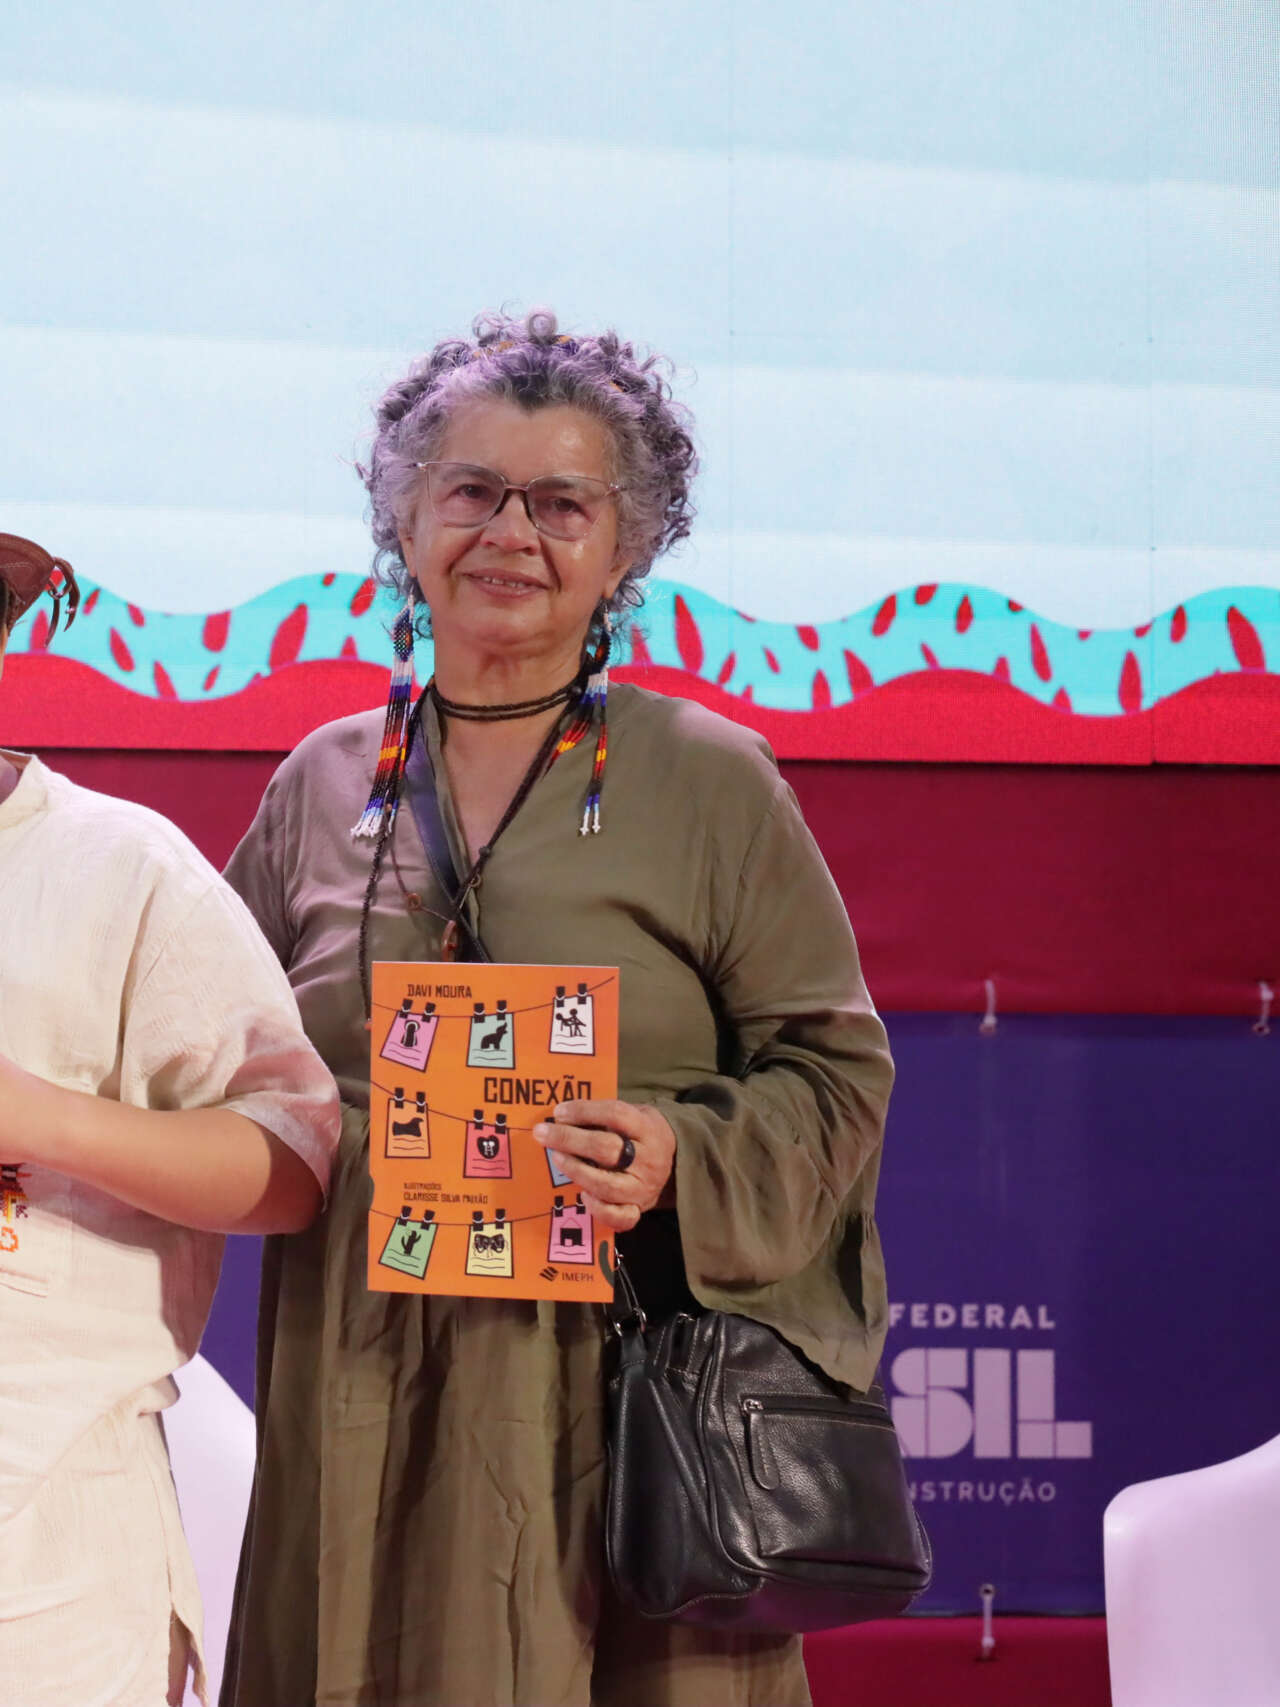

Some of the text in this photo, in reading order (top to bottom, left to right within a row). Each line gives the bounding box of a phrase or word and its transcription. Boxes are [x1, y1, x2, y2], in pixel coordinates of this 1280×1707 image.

[408, 984, 472, 998] DAVI MOURA
[483, 1075, 591, 1106] CONEXÃO
[562, 1272, 595, 1282] IMEPH
[889, 1303, 1056, 1330] FEDERAL
[891, 1347, 1093, 1459] SIL
